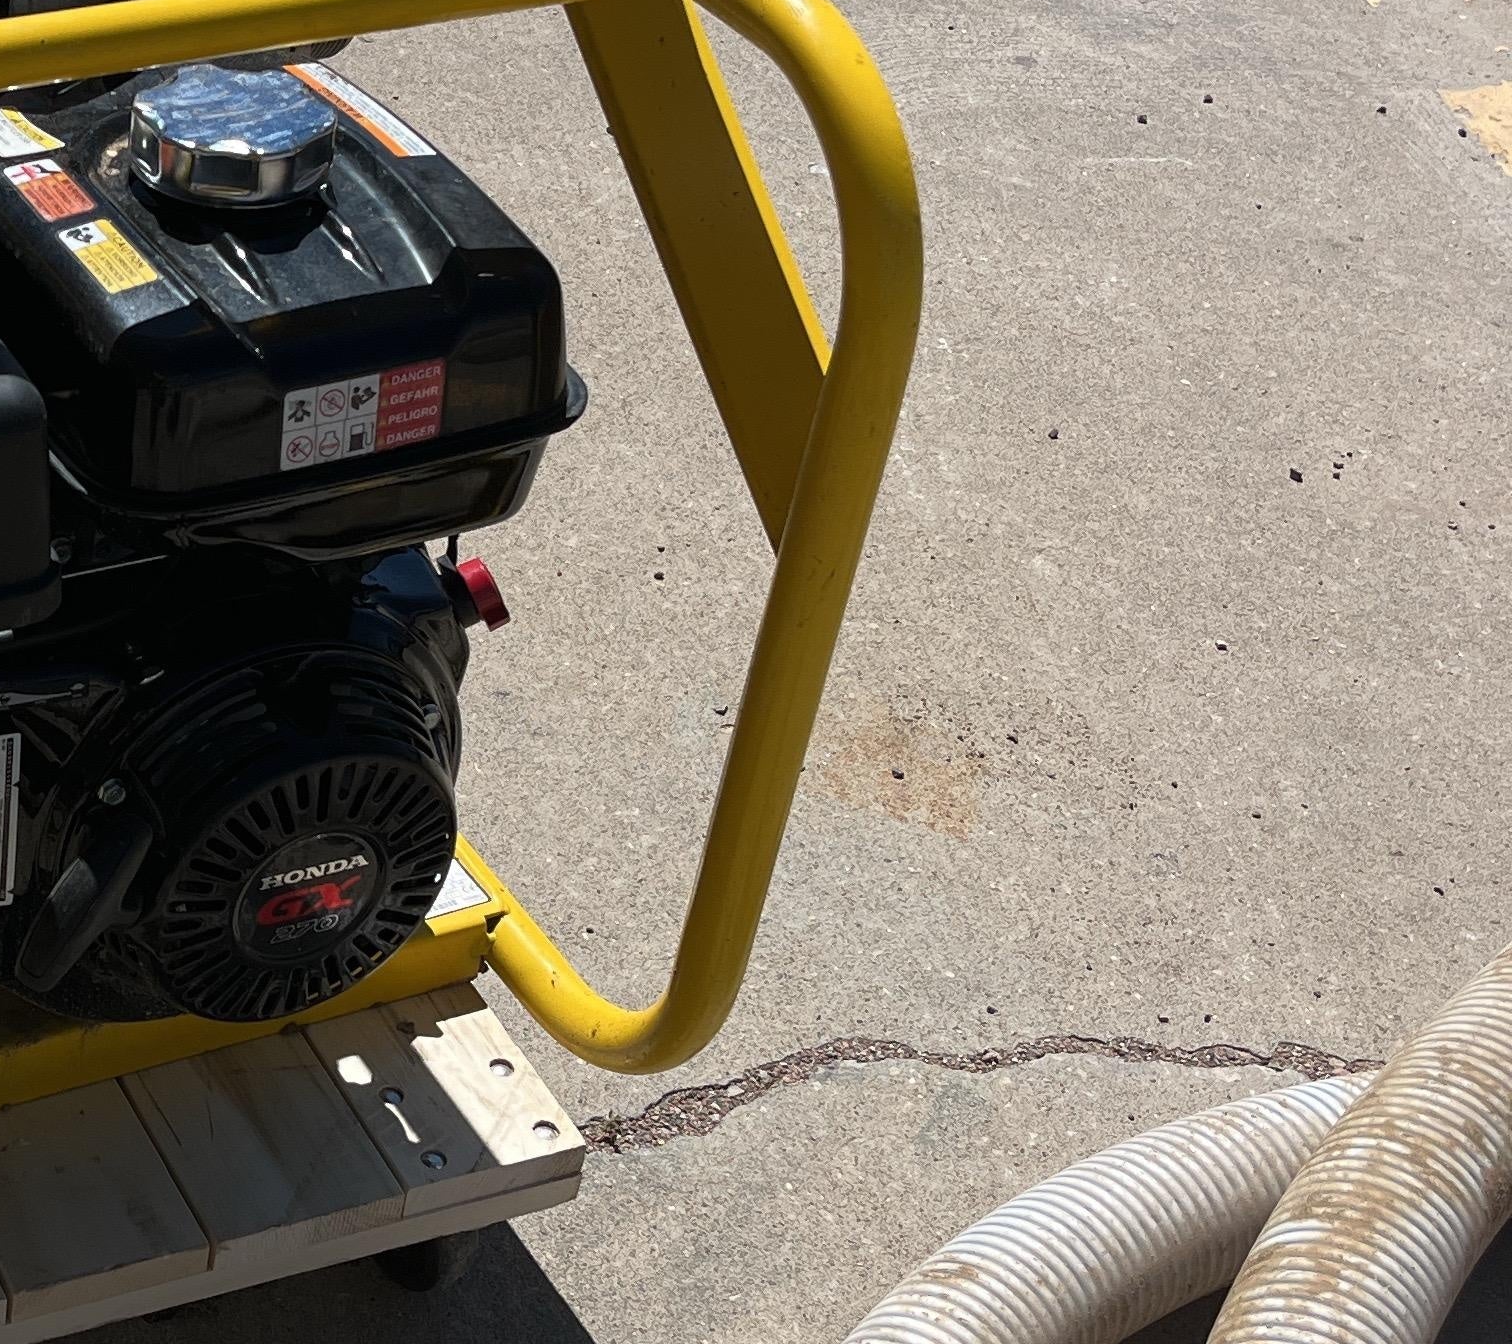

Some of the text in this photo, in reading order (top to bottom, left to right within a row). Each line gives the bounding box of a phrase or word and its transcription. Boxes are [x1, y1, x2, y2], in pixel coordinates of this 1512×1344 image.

[391, 366, 441, 384] DANGER
[391, 386, 439, 404] GEFAHR
[388, 406, 438, 424] PELIGRO
[386, 425, 435, 444] DANGER
[259, 854, 369, 891] HONDA
[256, 874, 362, 928] GX
[270, 913, 339, 946] 270
